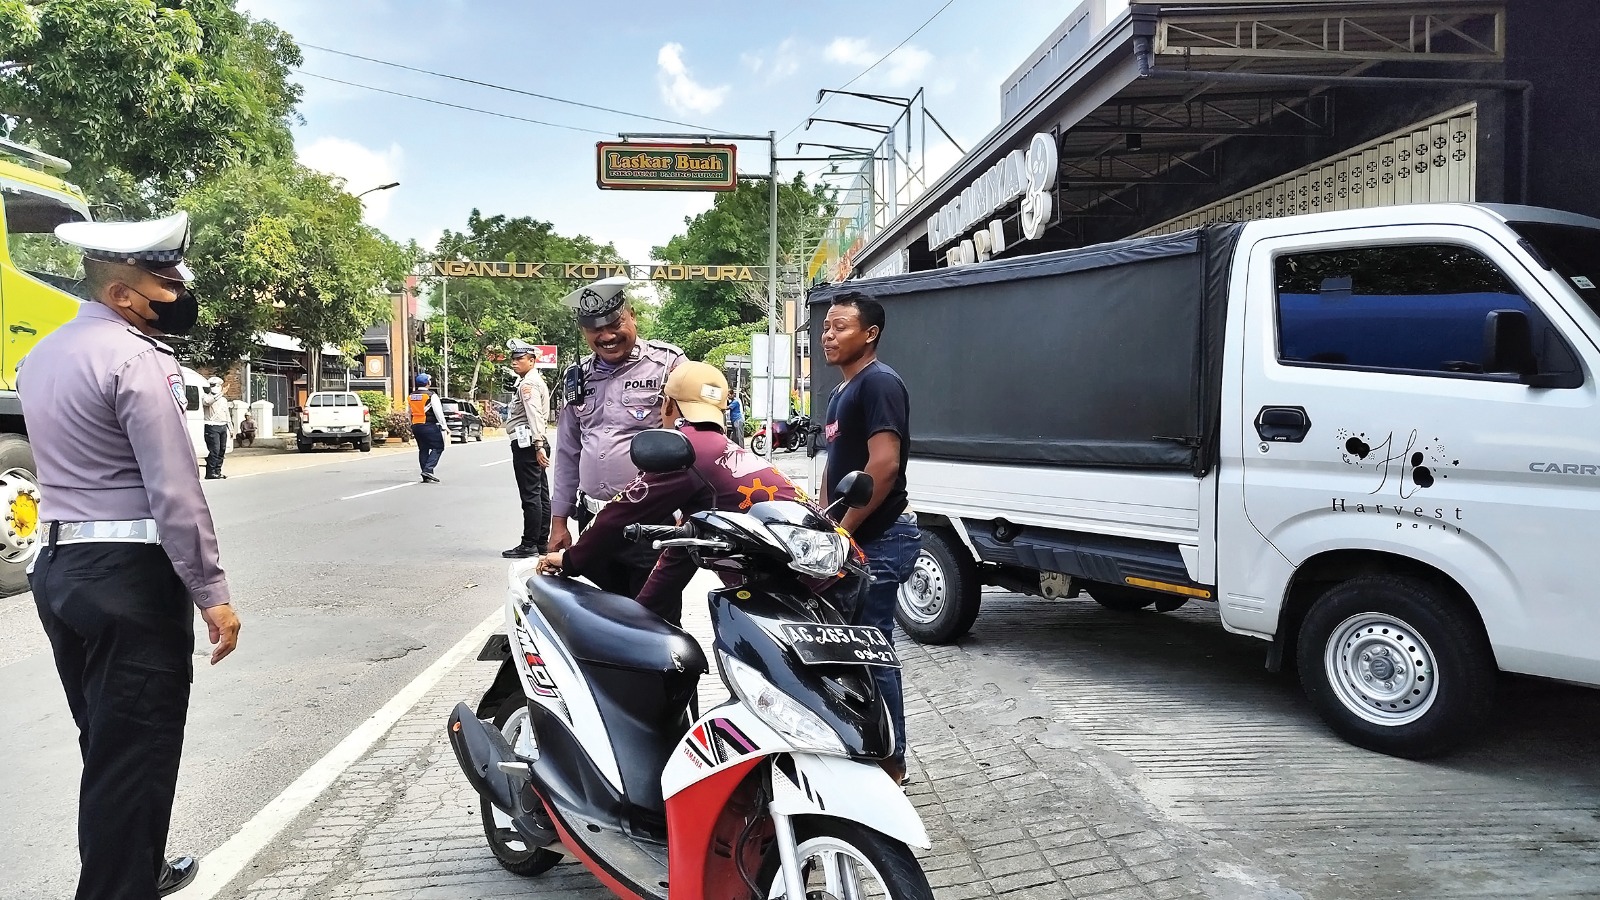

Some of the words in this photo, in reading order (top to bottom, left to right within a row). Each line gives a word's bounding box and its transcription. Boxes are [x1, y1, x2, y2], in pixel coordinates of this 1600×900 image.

[609, 153, 673, 170] Laskar
[675, 154, 724, 171] Buah
[432, 261, 546, 278] NGANJUK
[565, 264, 629, 279] KOTA
[653, 265, 753, 281] ADIPURA
[625, 380, 657, 389] POLRI
[1529, 462, 1600, 475] CARR
[1332, 498, 1462, 520] Harvest
[1396, 523, 1461, 534] party
[787, 626, 814, 643] AG
[683, 745, 703, 769] YAMAHA
